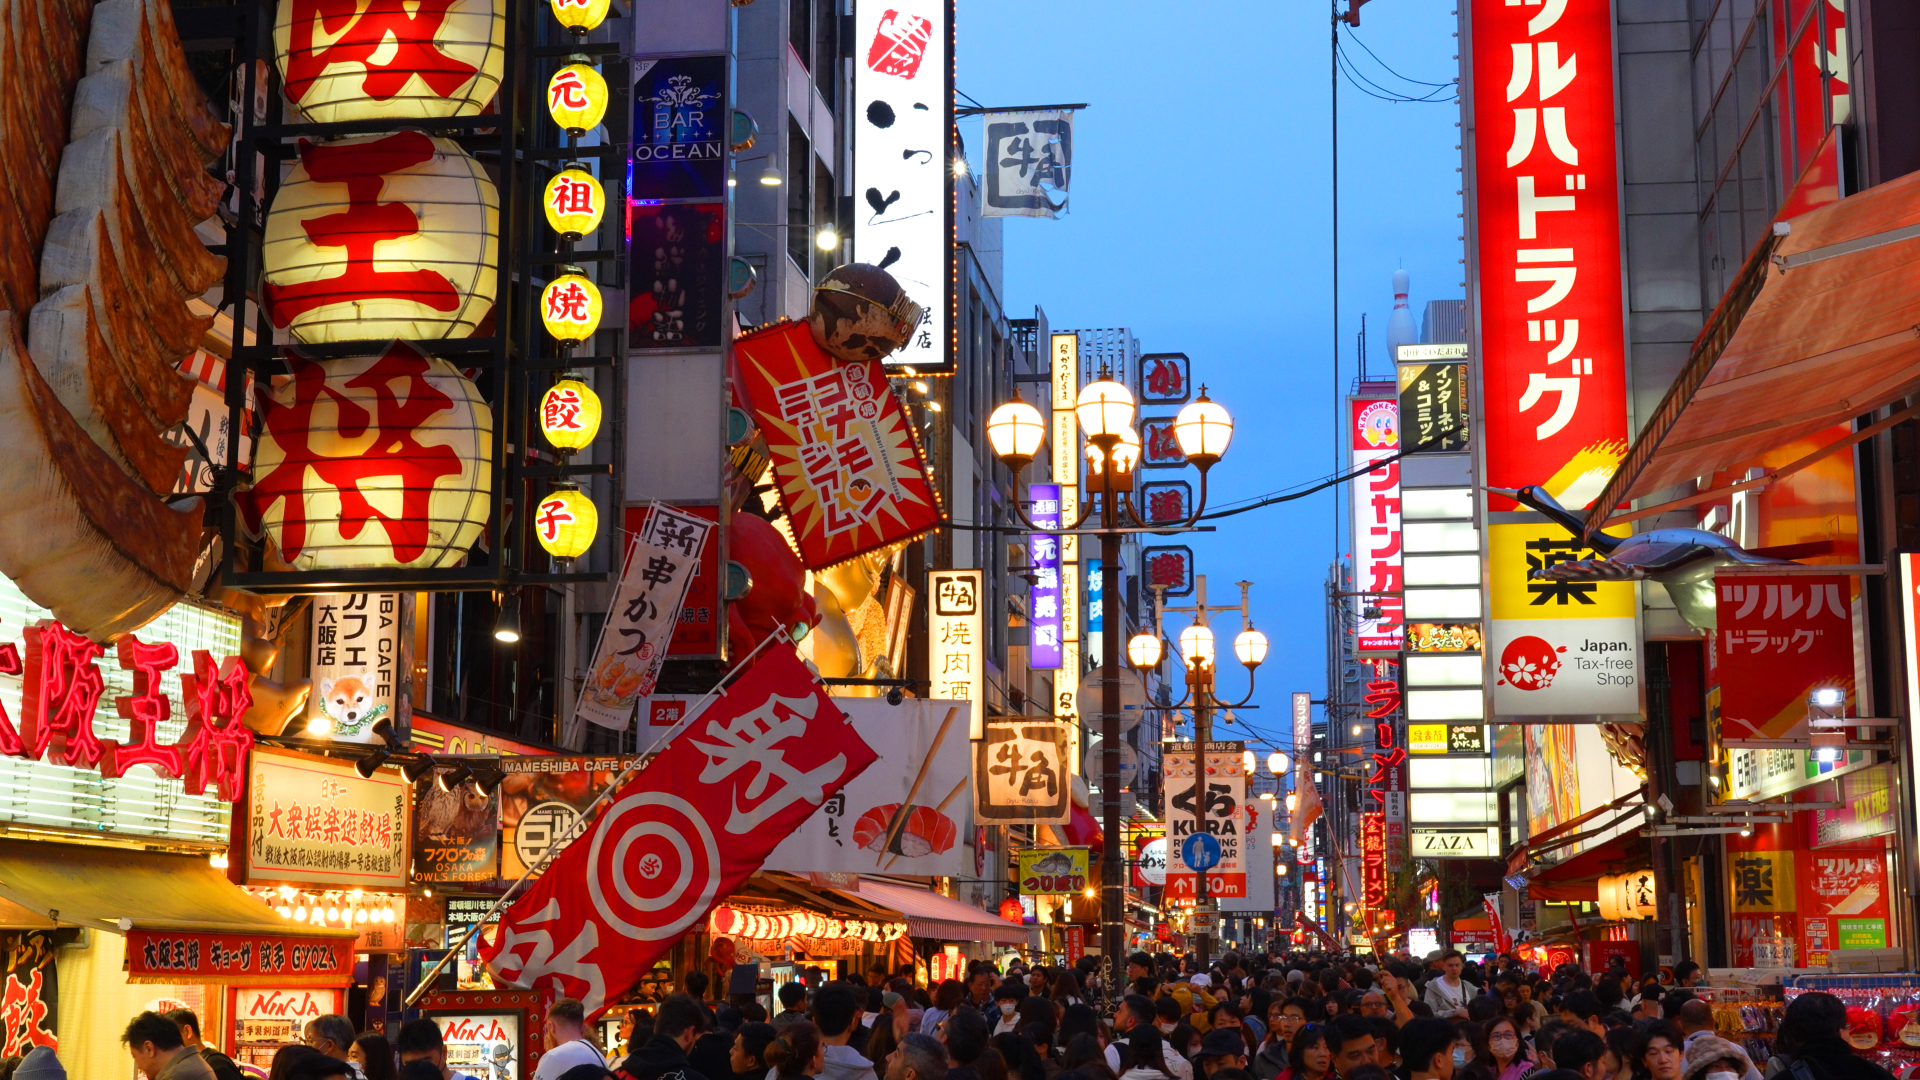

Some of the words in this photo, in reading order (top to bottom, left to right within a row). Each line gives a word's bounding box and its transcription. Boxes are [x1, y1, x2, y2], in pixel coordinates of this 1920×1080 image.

[635, 61, 650, 71] 3F
[655, 111, 704, 129] BAR
[636, 143, 721, 160] OCEAN
[536, 0, 594, 541] 元祖焼餃子
[1401, 367, 1415, 381] 2F
[848, 363, 878, 419] 道頓堀
[653, 516, 699, 557] 新
[617, 555, 677, 656] 串かつ
[941, 583, 973, 607] 牛角
[1721, 584, 1847, 620] ツルハ
[317, 604, 338, 666] 大阪店
[1725, 629, 1824, 654] ドラッグ
[1580, 639, 1632, 654] Japan.
[376, 637, 392, 698] CAFE
[1574, 657, 1634, 670] Tax-free
[1597, 673, 1635, 688] Shop
[656, 708, 679, 722] 2階
[1171, 742, 1238, 750] 道頓商店会
[505, 761, 579, 773] MAMESHIBA
[584, 761, 619, 771] CAFE
[687, 692, 847, 835] 射
[989, 743, 1058, 797] 牛角
[321, 778, 347, 800] 日本一
[251, 773, 266, 857] 景品付
[1489, 803, 1497, 811] B1
[1853, 795, 1872, 824] TAX
[266, 799, 393, 851] 大衆娯楽遊戯場
[392, 795, 404, 868] 景品付
[448, 837, 465, 845] 大阪
[1425, 836, 1475, 849] ZAZA
[424, 847, 487, 862] フクロウの森
[1220, 849, 1238, 859] AR
[1366, 817, 1384, 906] 金龍ラーメン
[415, 872, 448, 881] OWL'S
[452, 872, 494, 881] FOREST
[435, 863, 473, 872] OSAKA
[1818, 858, 1877, 874] ツルハ
[1735, 857, 1773, 906] 薬
[1818, 876, 1862, 889] ドラッグ
[365, 932, 383, 948] 大阪店
[143, 937, 200, 970] 大阪王将
[209, 941, 251, 971] ギョーザ
[259, 942, 286, 972] 餃子
[291, 944, 338, 971] GYOZA
[249, 990, 320, 1017] NINJA
[442, 1018, 507, 1042] NINJA
